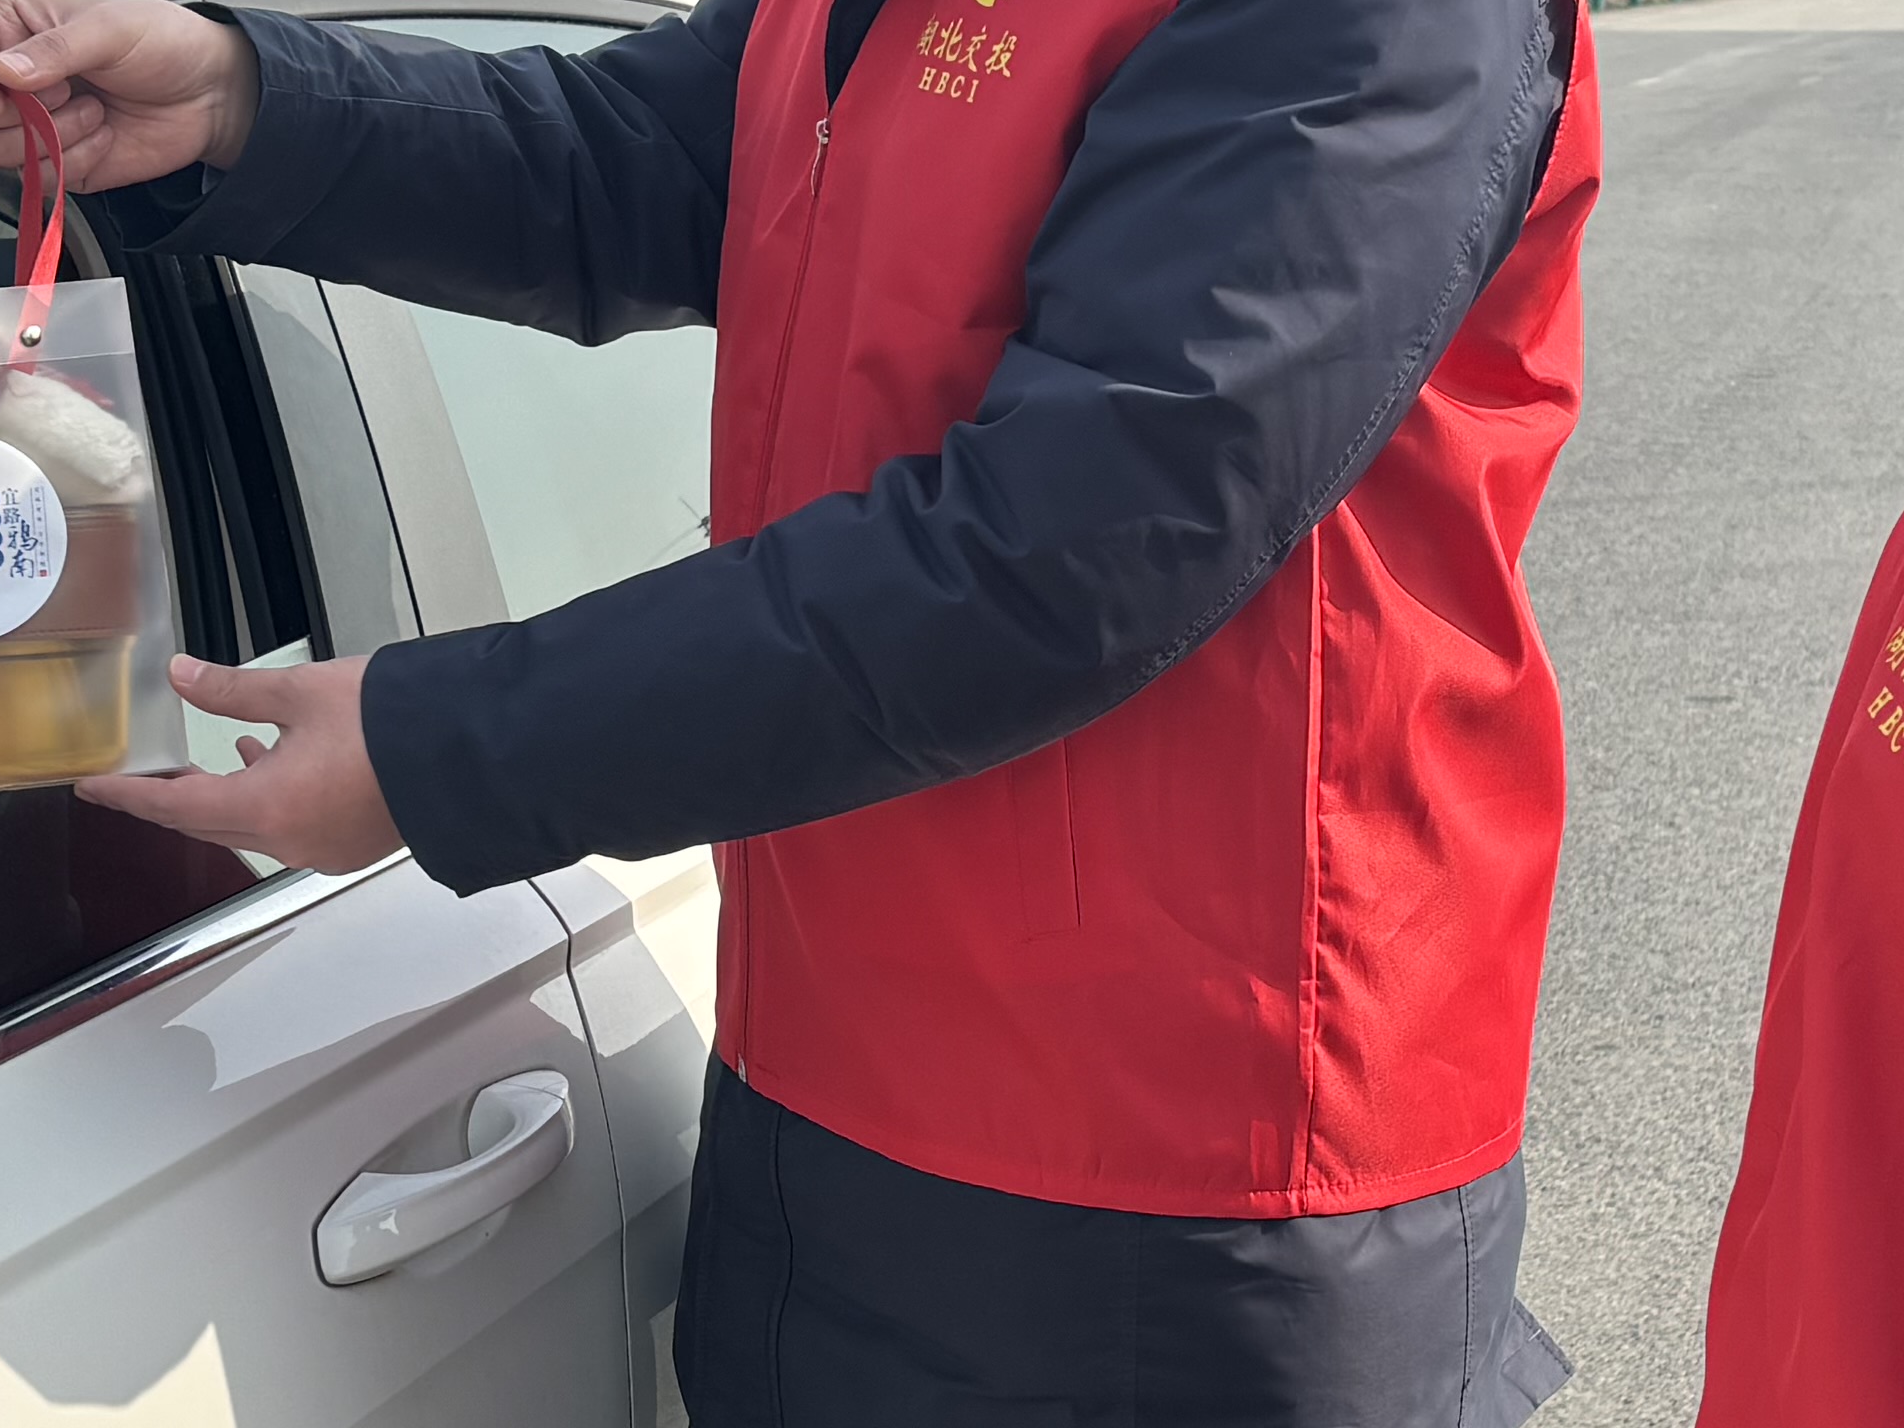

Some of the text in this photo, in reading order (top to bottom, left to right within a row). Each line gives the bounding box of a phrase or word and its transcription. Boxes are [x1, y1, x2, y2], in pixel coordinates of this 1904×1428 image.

[916, 12, 1018, 78] 湖北交投
[917, 66, 979, 104] HBCI
